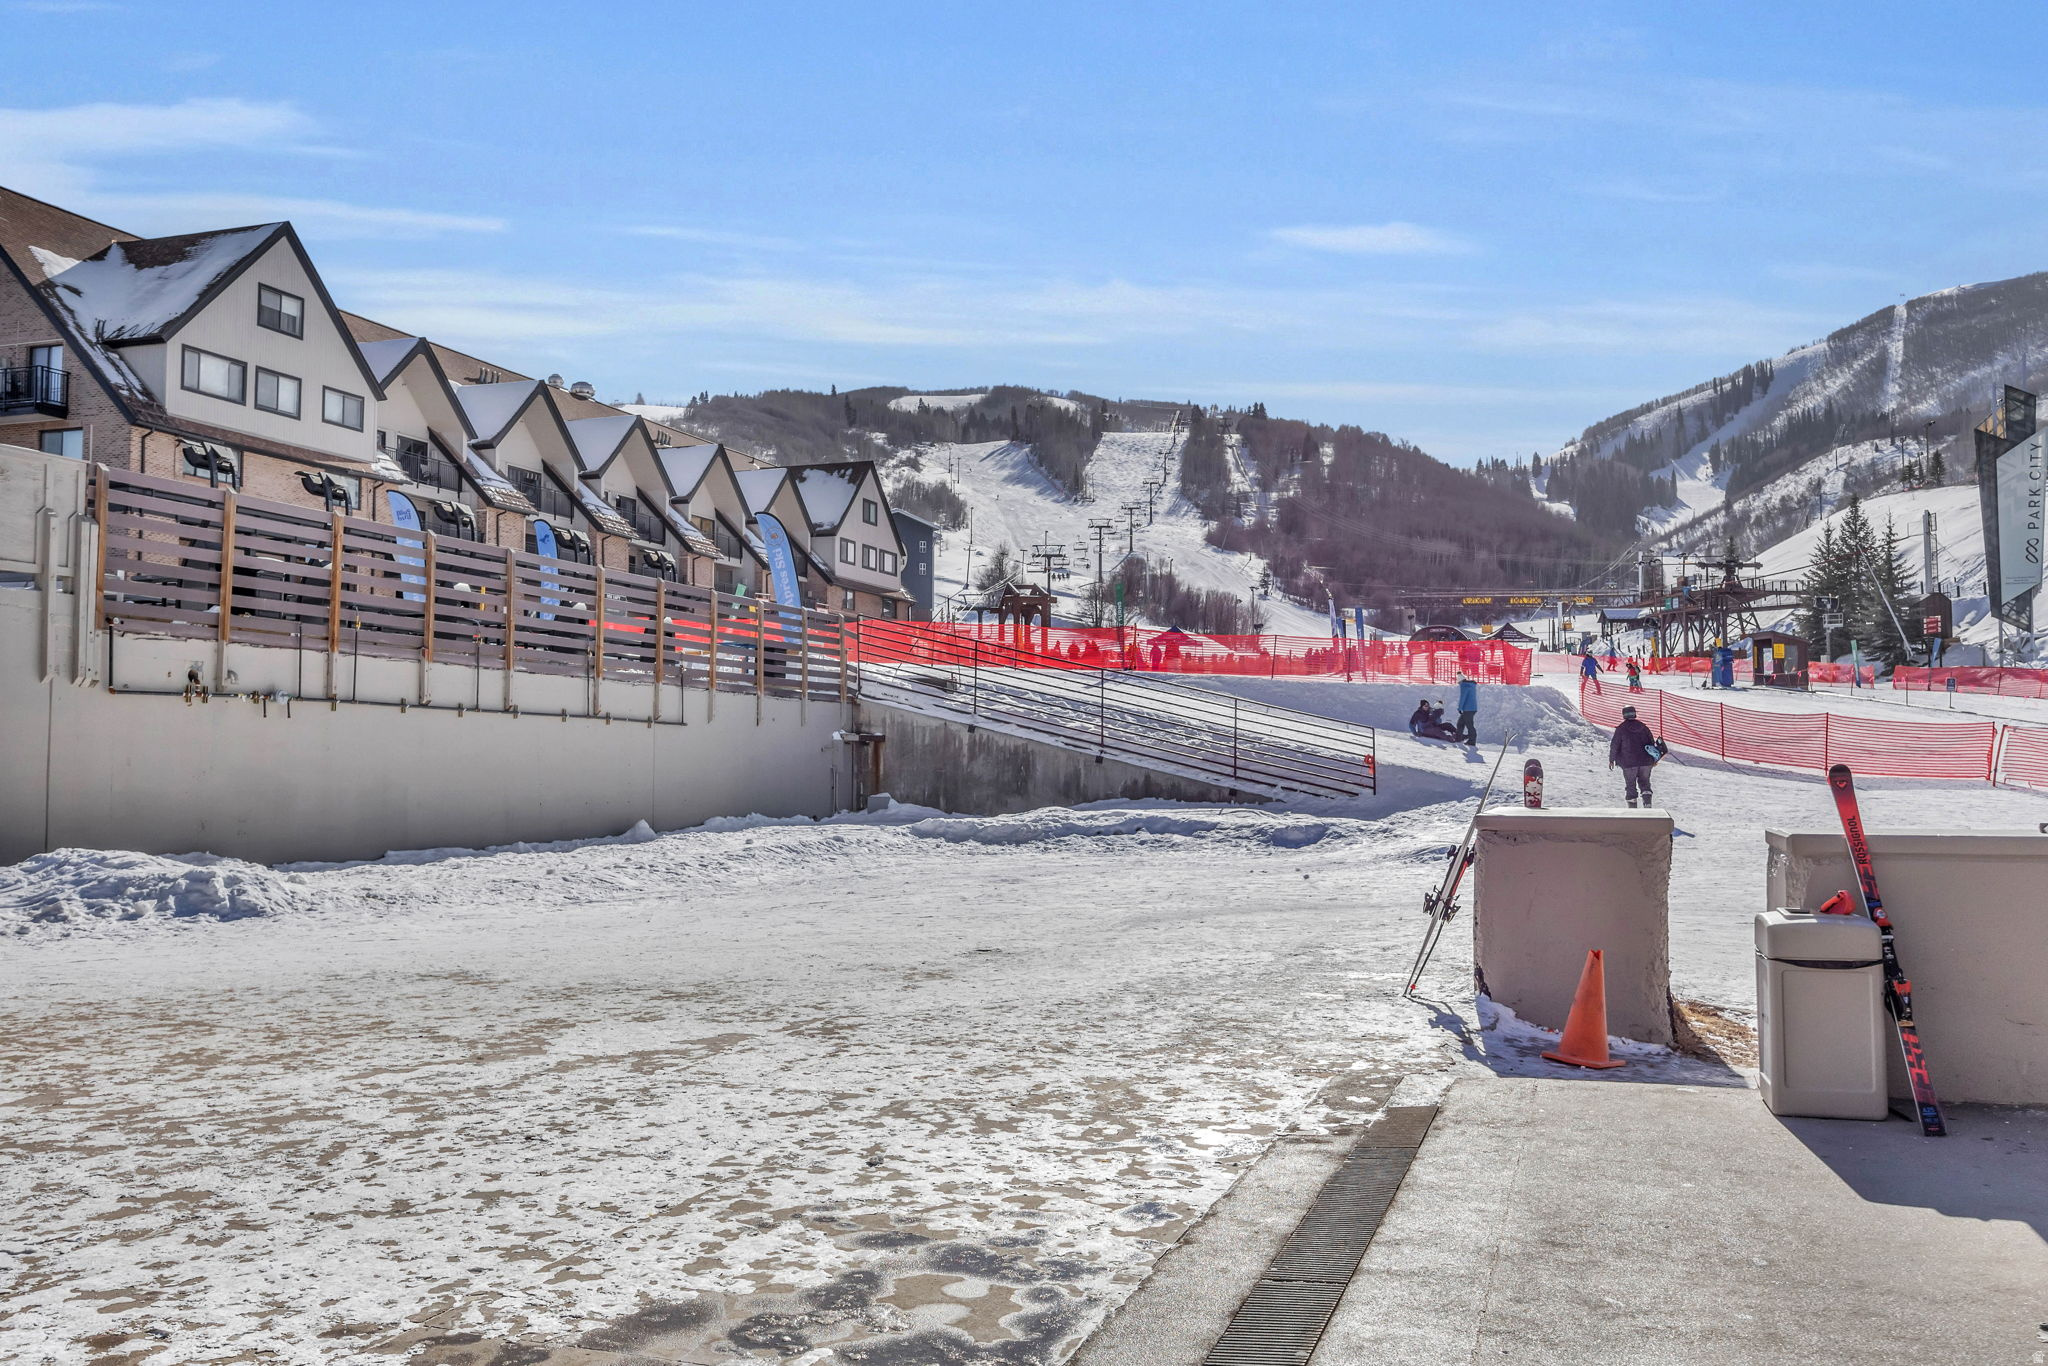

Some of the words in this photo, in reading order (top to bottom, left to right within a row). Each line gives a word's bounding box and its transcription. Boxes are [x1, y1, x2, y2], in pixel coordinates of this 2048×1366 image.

[2029, 442, 2042, 481] CITY
[2027, 488, 2041, 530] PARK
[772, 548, 785, 569] Ski
[1847, 815, 1868, 865] ROSSIGNOL
